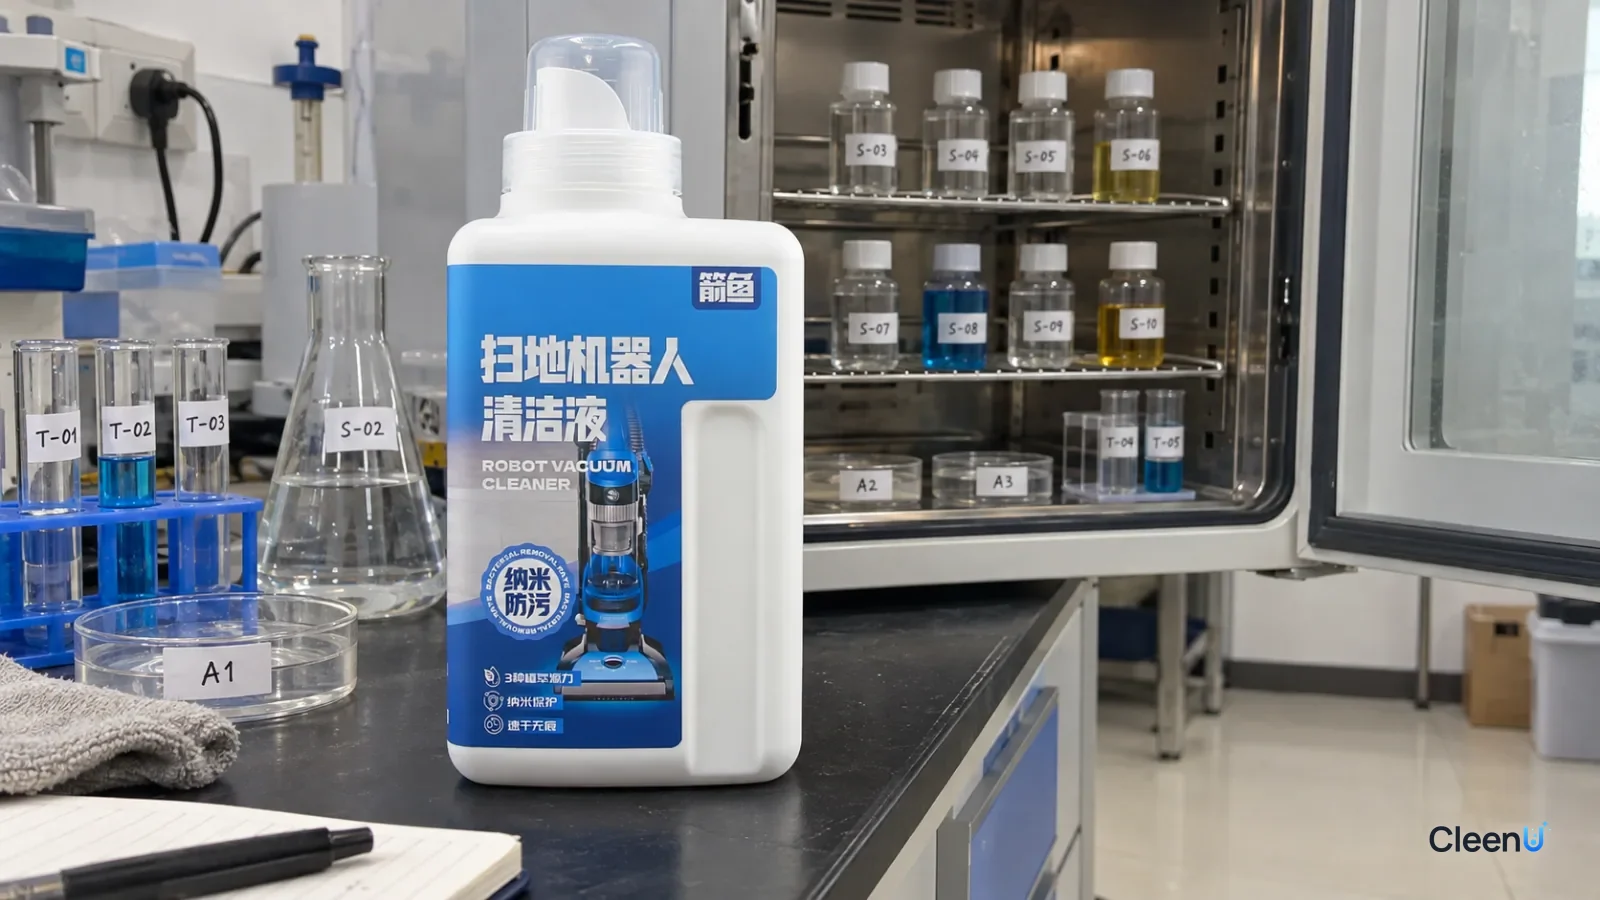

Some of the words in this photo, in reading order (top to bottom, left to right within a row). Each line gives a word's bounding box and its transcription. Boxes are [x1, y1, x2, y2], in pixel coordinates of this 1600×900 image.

[856, 143, 887, 158] S-03
[949, 149, 979, 163] S-04
[1024, 150, 1057, 164] S-05
[1122, 148, 1151, 162] S-06
[699, 272, 755, 303] 箭鱼
[860, 322, 890, 336] S-07
[948, 322, 979, 336] S-08
[1033, 319, 1063, 334] S-09
[1130, 317, 1158, 331] S-10
[480, 334, 694, 386] 扫地机器人
[186, 415, 225, 433] T-03
[481, 395, 608, 443] 清洁液
[109, 421, 152, 439] T-02
[340, 420, 385, 438] S-02
[36, 427, 77, 448] T-01
[1106, 436, 1134, 449] T-04
[1152, 436, 1180, 449] T-05
[482, 460, 548, 473] ROBOT
[551, 459, 632, 473] VACUUM
[482, 477, 571, 491] CLEANER
[856, 478, 878, 493] A2
[993, 475, 1013, 489] A3
[520, 548, 558, 567] REMOVAL
[503, 567, 552, 592] 纳米
[505, 592, 552, 619] 防污
[201, 661, 235, 686] A1
[507, 696, 557, 708] 纳米保护
[507, 720, 557, 732] 速干无痕
